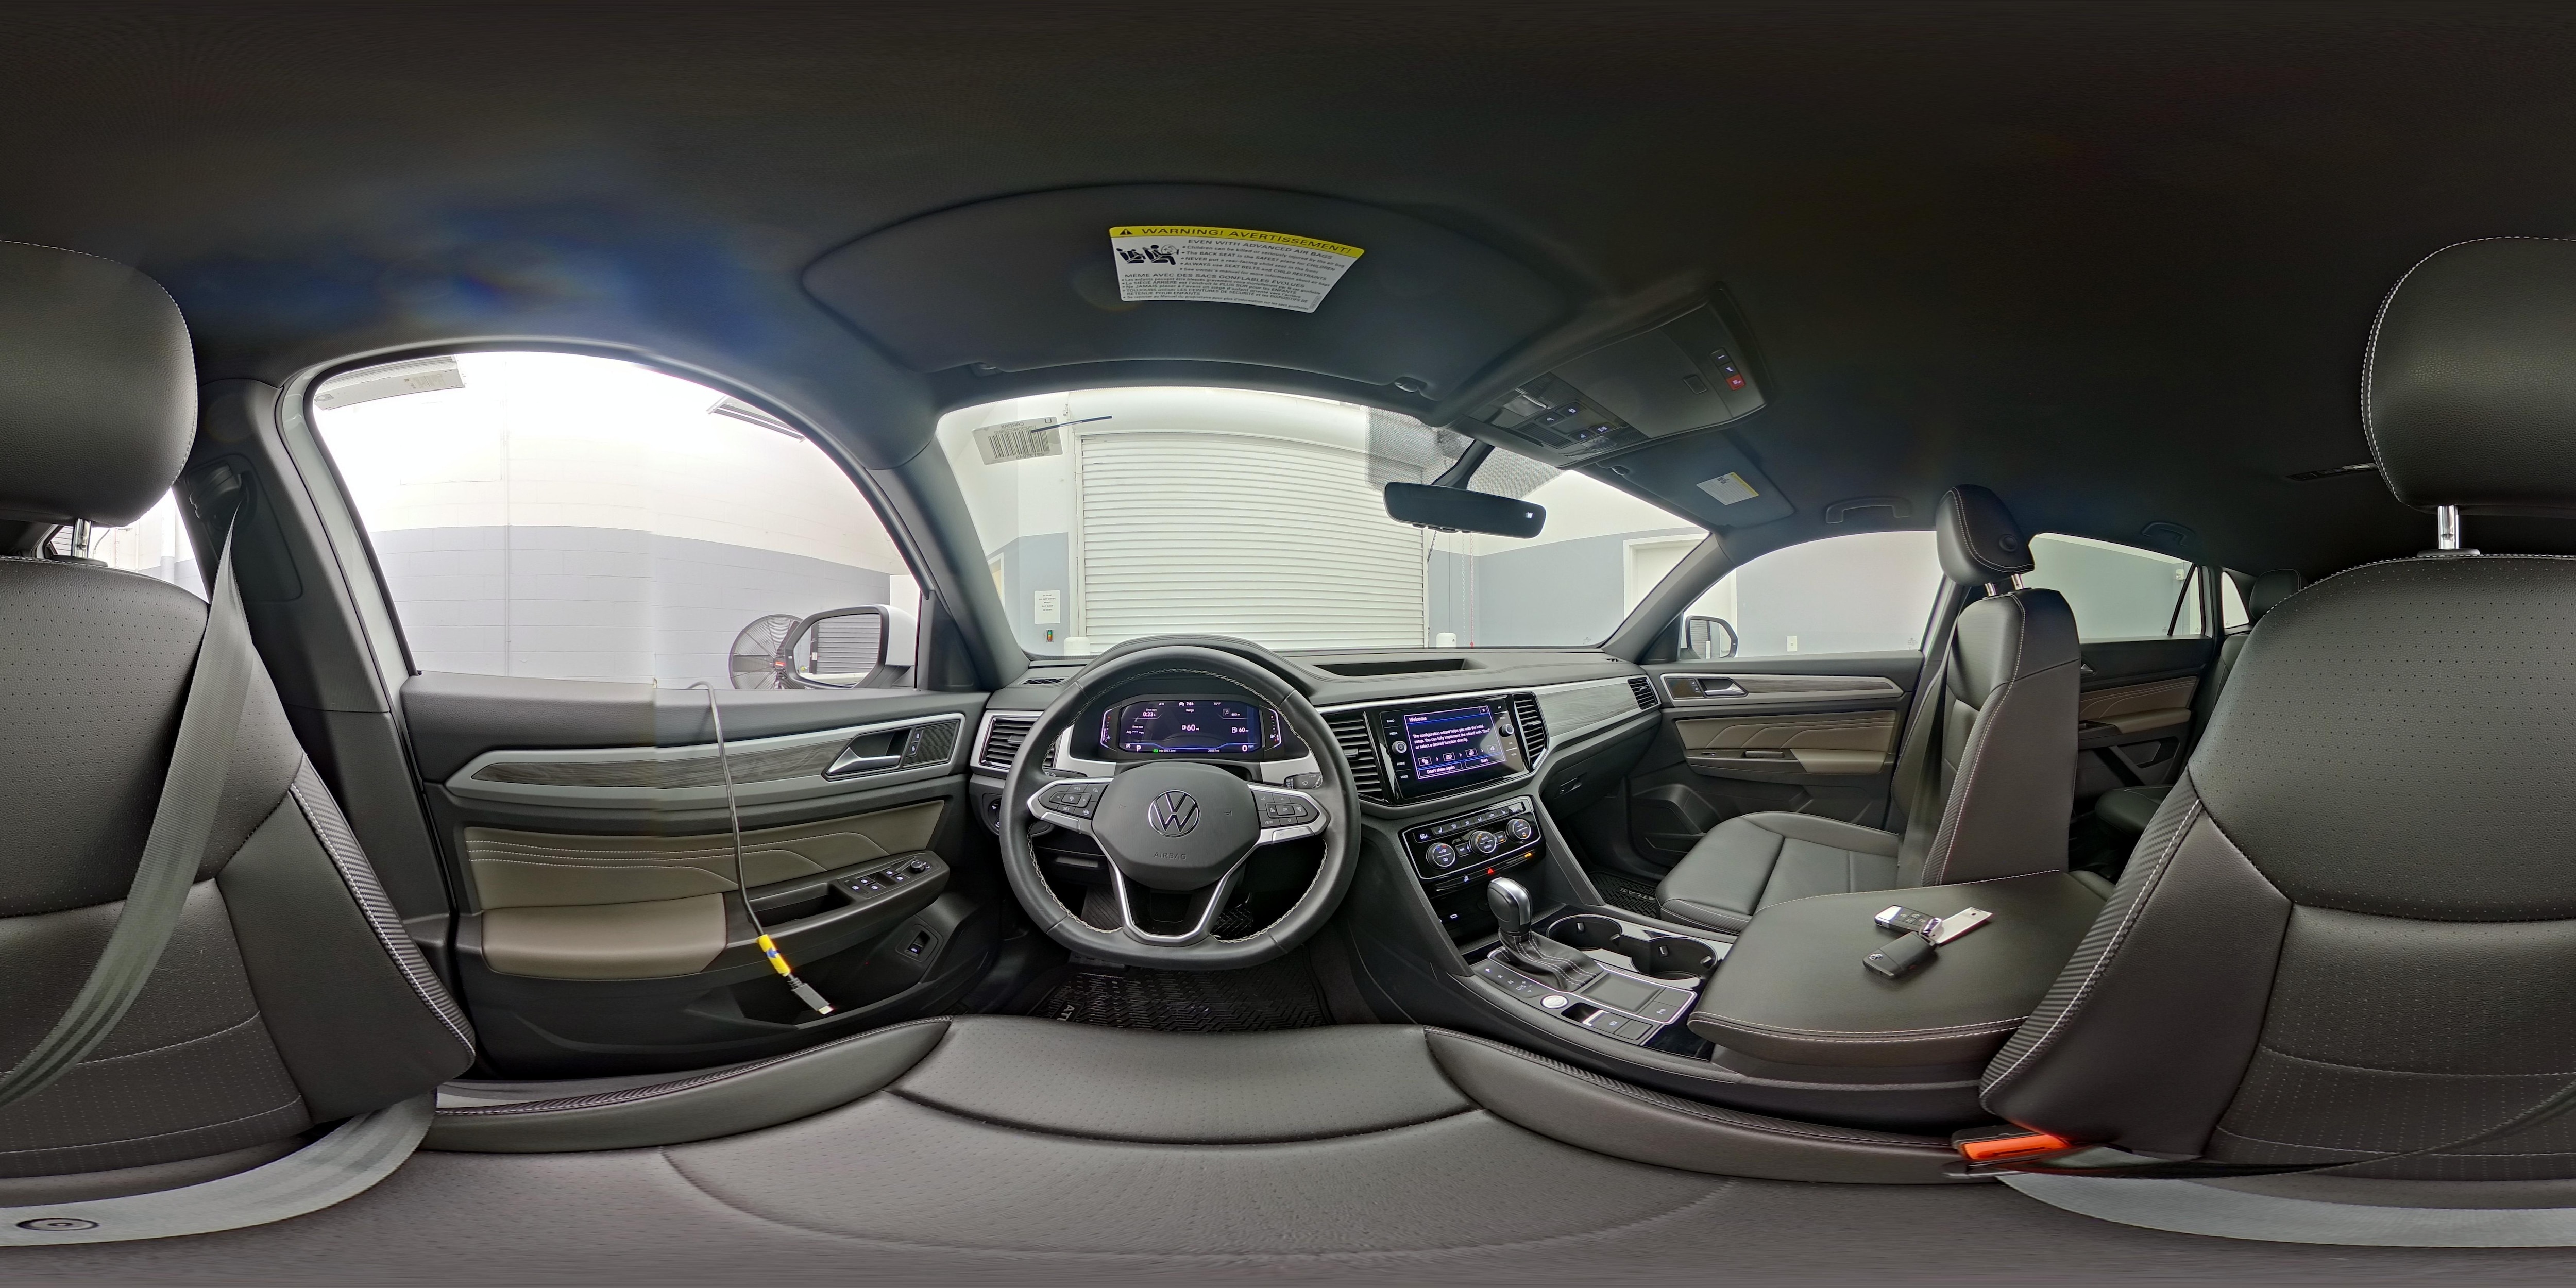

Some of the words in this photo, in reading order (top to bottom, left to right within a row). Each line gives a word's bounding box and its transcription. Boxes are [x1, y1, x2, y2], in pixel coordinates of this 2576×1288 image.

[1228, 230, 1352, 254] AVERTISSEMENT!
[1242, 242, 1292, 252] ADVANCED
[1306, 263, 1336, 271] CHILDREN
[1291, 272, 1327, 280] RESTRAINTS
[1619, 888, 1656, 901] ATLAS
